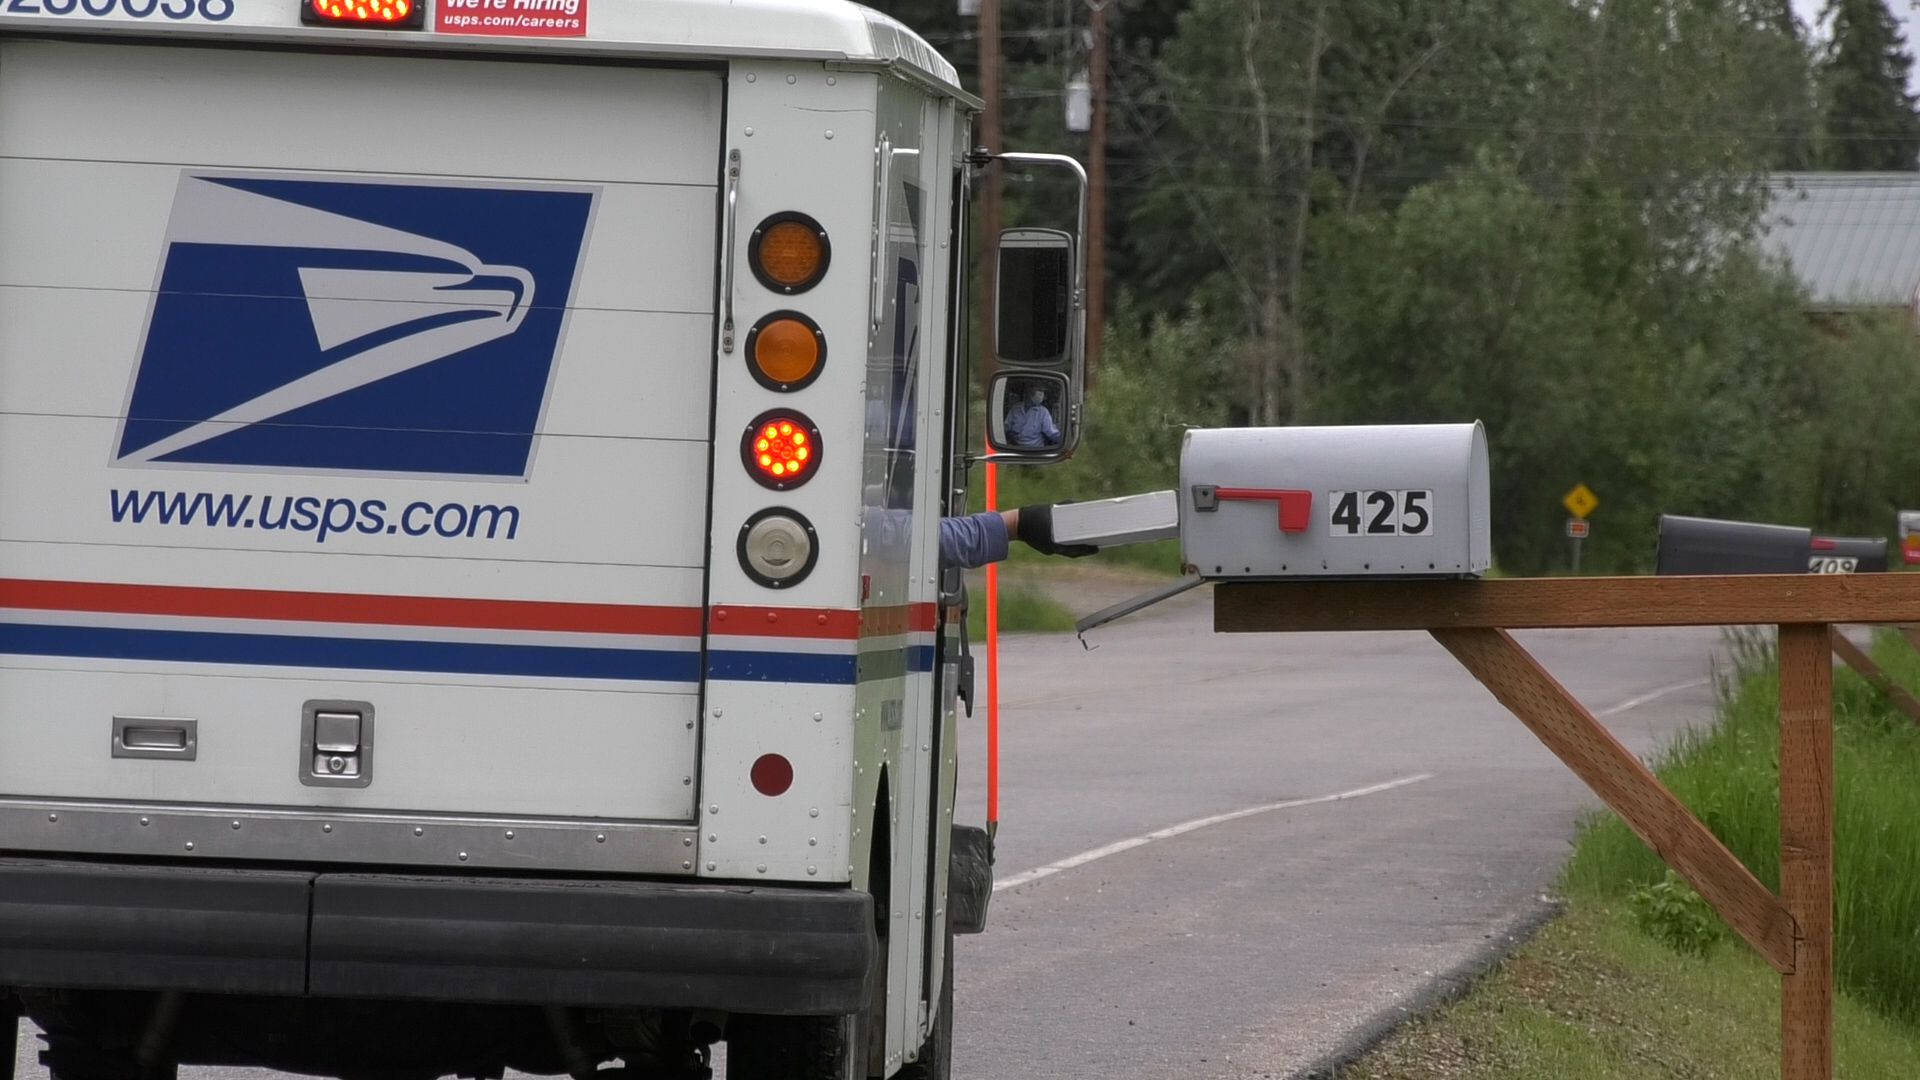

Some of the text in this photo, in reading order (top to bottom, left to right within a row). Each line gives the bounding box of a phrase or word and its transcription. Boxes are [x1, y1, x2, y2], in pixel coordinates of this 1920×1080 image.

[447, 0, 507, 9] Were
[444, 14, 580, 29] usps.com/careers
[109, 489, 520, 543] www.usps.com
[1331, 490, 1429, 534] 425
